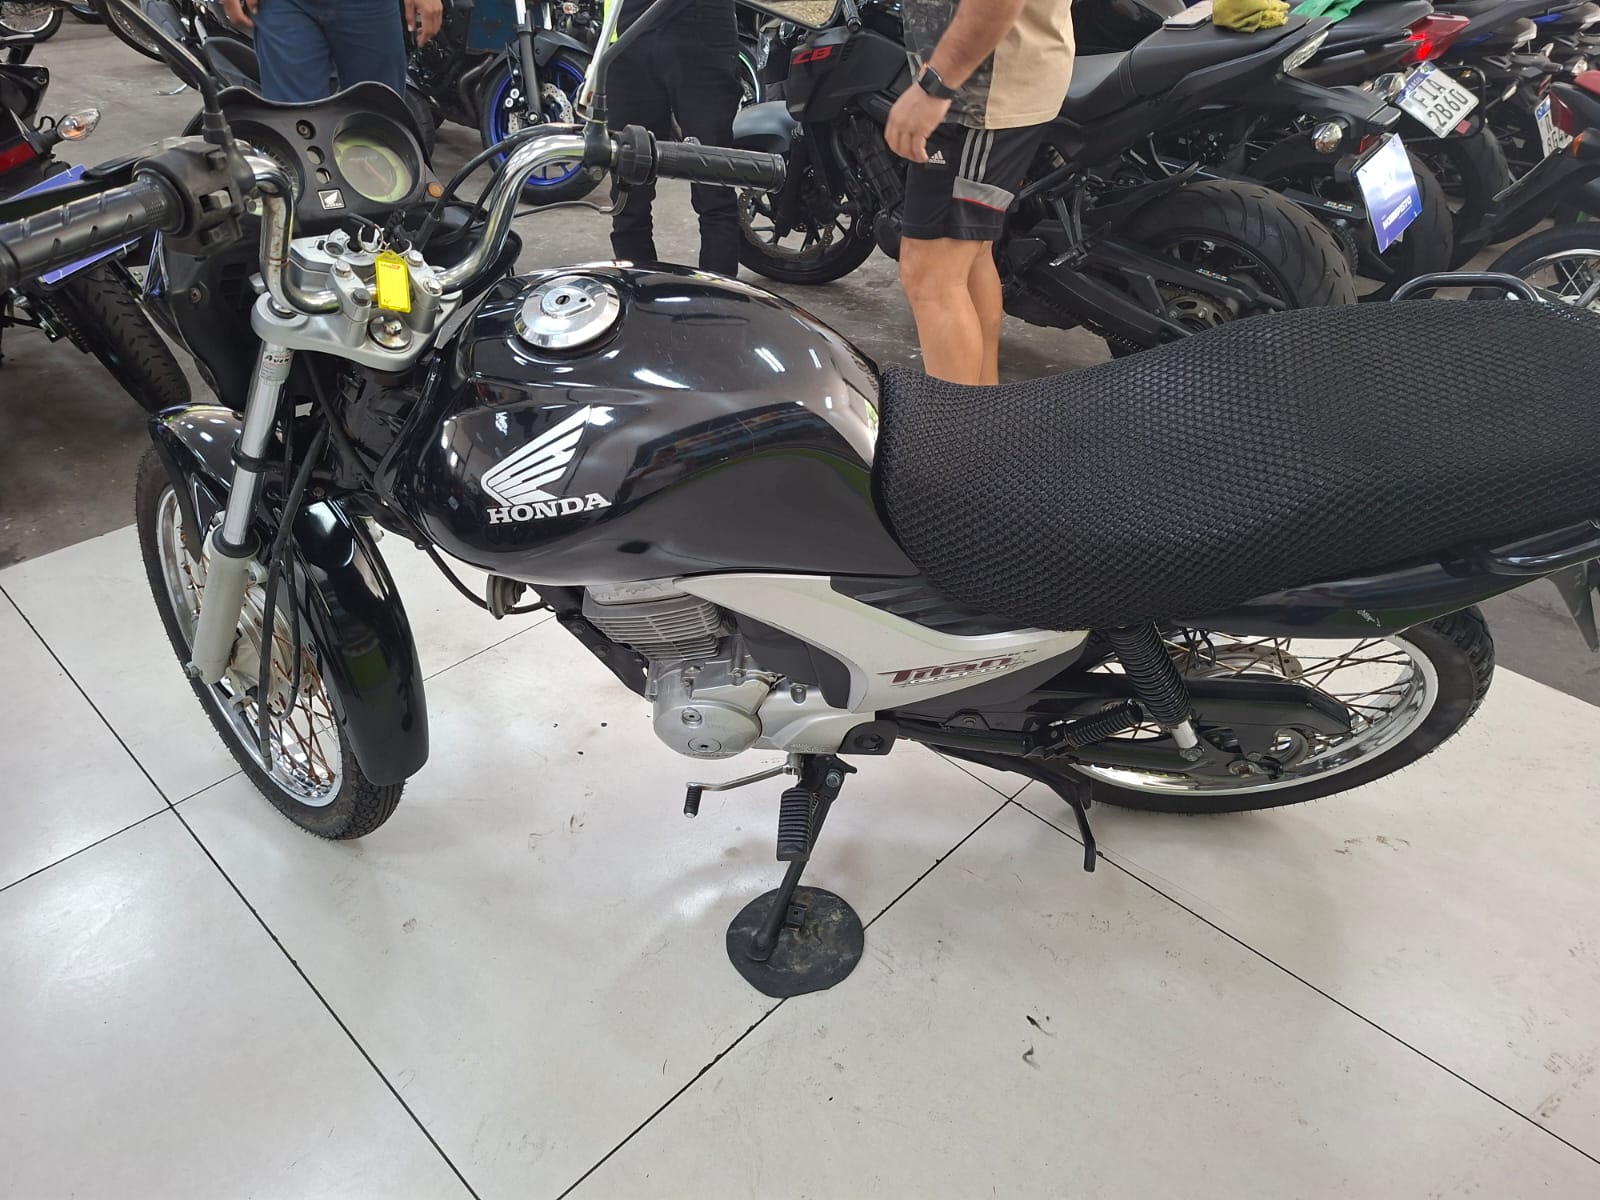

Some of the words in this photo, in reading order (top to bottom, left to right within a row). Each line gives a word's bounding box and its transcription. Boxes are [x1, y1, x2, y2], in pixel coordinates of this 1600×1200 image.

[792, 46, 833, 65] CB
[1410, 79, 1447, 109] FIA
[1427, 89, 1469, 127] 2B60
[486, 492, 613, 525] HONDA
